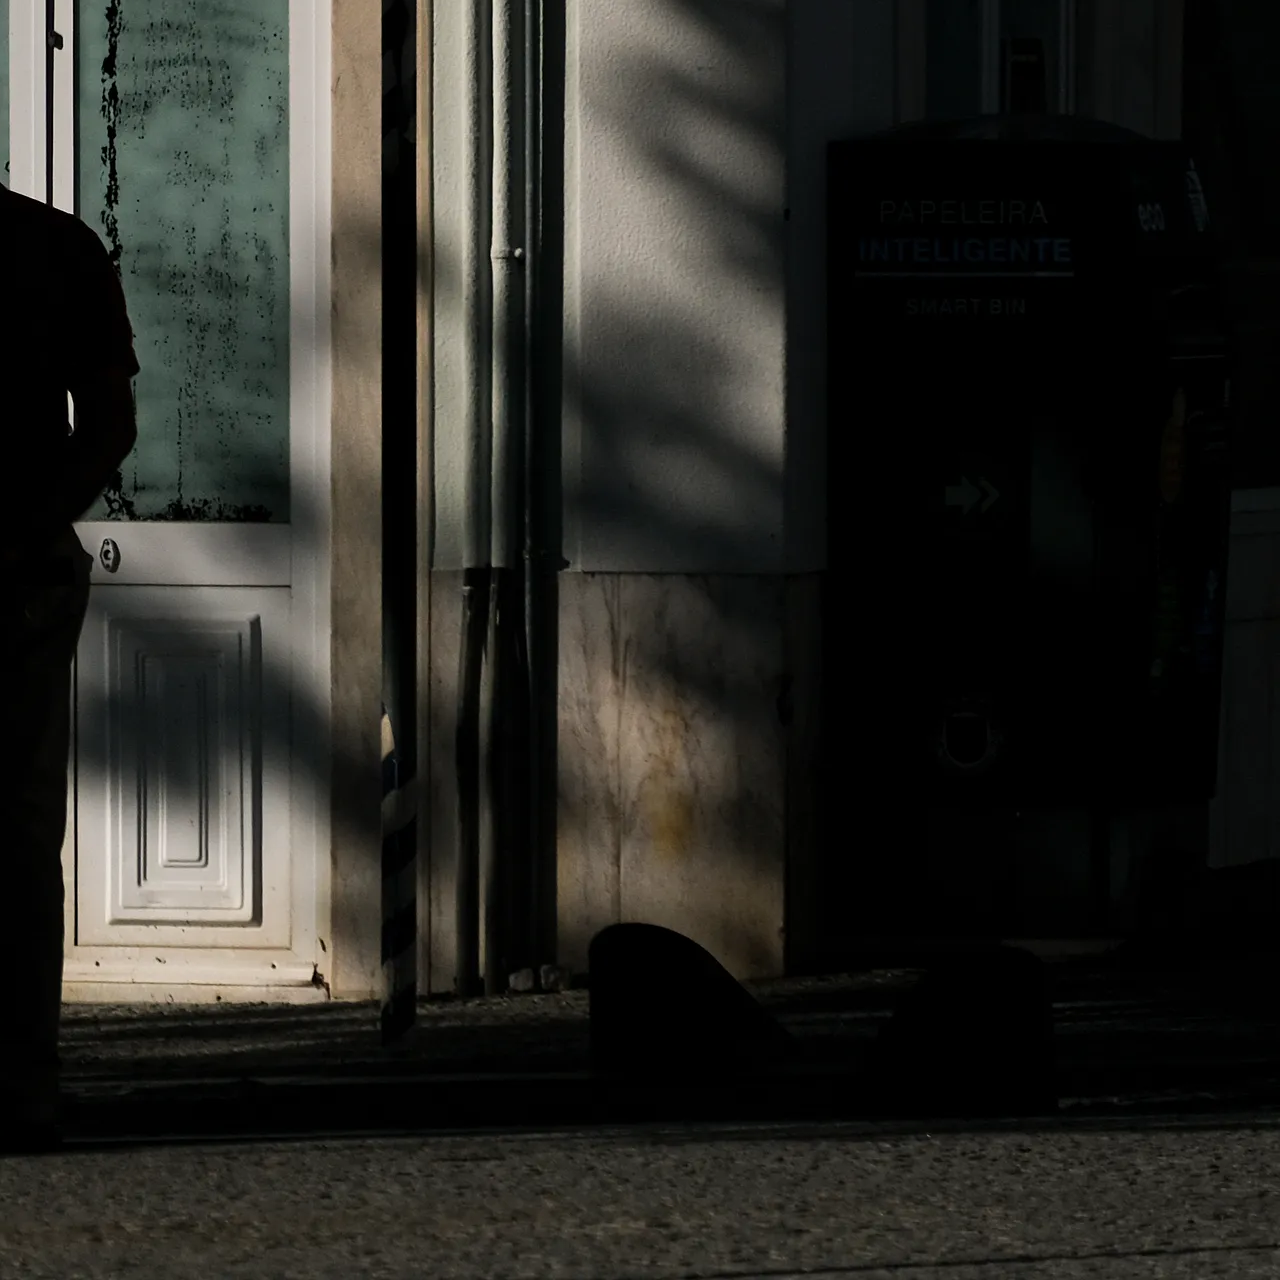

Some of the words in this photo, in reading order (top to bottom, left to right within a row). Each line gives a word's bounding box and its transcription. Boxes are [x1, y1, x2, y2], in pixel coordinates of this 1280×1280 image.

[878, 200, 1049, 225] PAPELEIRA
[857, 236, 1074, 264] INTELIGENTE
[905, 297, 982, 316] SMART
[989, 297, 1027, 316] BIN
